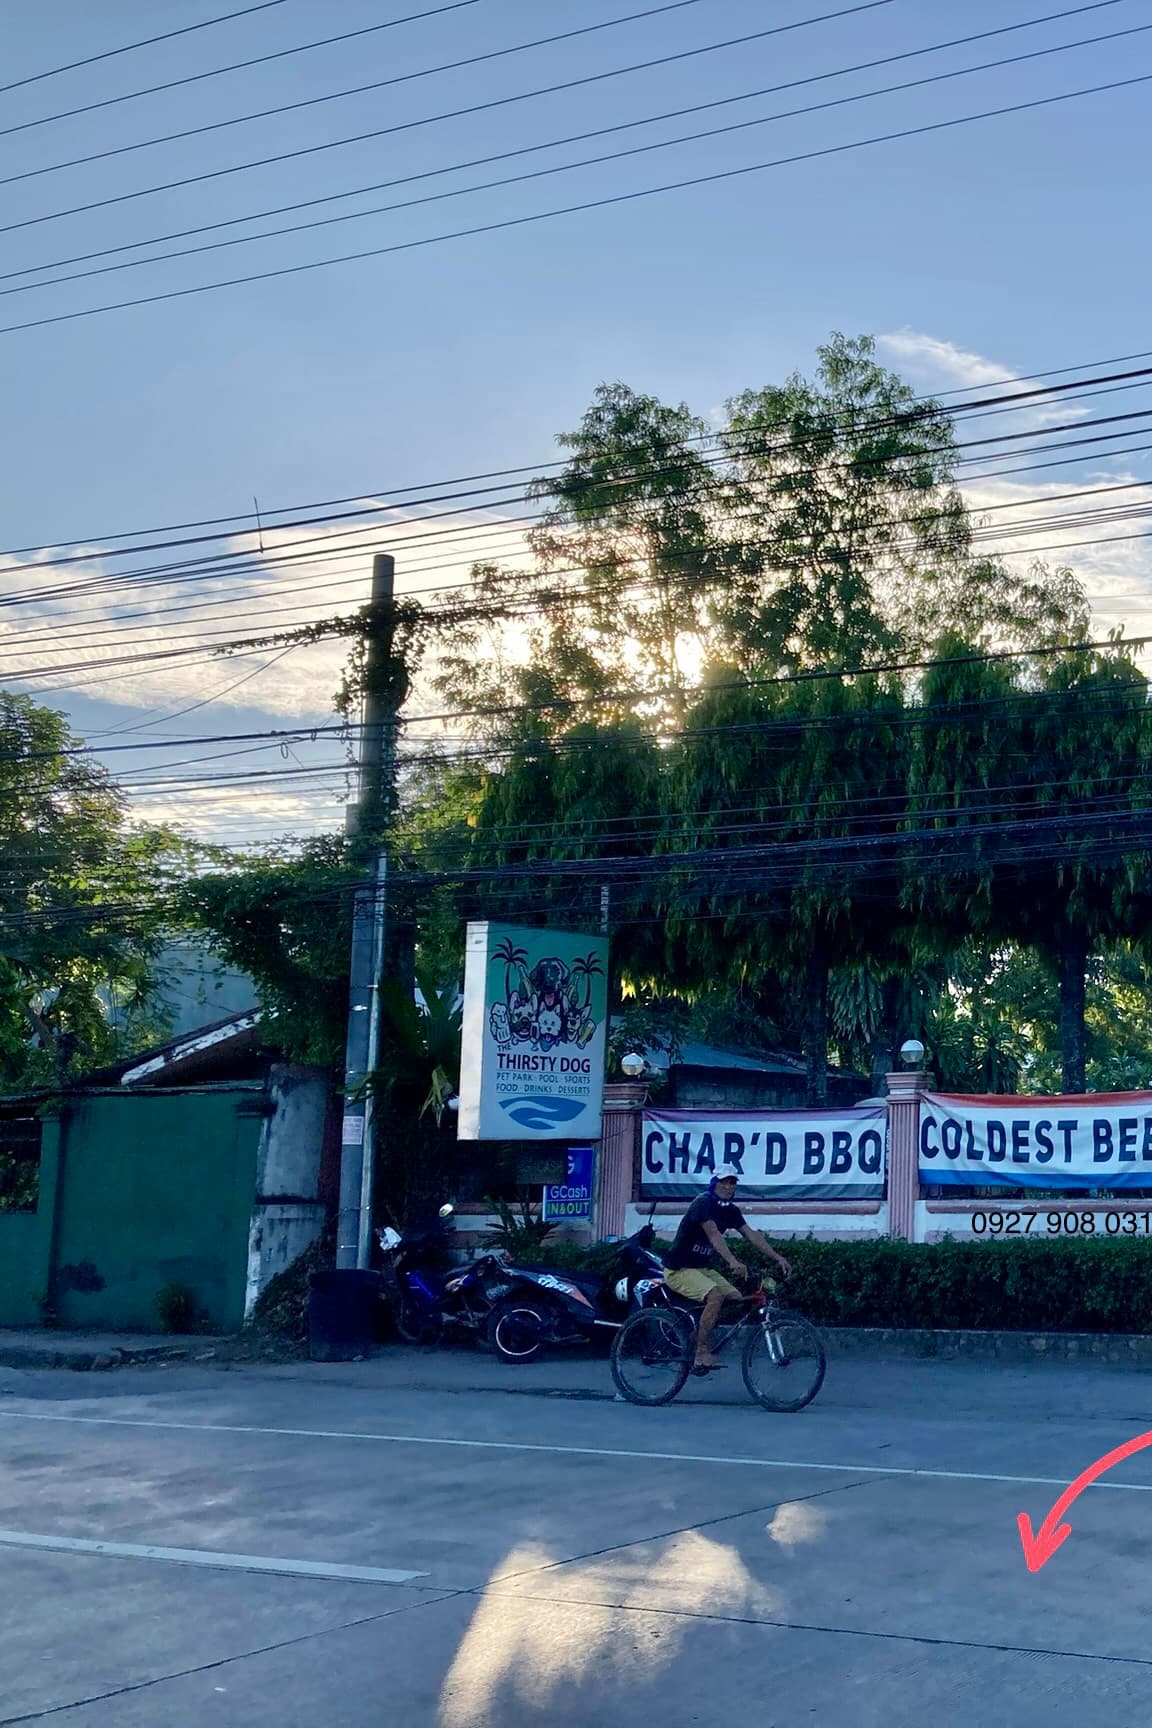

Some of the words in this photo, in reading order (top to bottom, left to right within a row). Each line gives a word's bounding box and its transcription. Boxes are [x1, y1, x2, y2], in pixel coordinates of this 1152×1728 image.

[497, 1044, 511, 1052] THE
[496, 1053, 557, 1072] THIRSTY
[560, 1057, 591, 1073] DOG
[496, 1072, 510, 1081] PET
[512, 1073, 533, 1082] PARK
[539, 1074, 559, 1083] POOL
[564, 1075, 591, 1084] SPORTS
[496, 1083, 519, 1092] FOOD
[524, 1084, 552, 1093] DRINKS
[558, 1085, 590, 1094] DESSERTS
[920, 1115, 1079, 1163] COLDEST
[645, 1131, 788, 1175] CHAR'D
[803, 1128, 883, 1176] BBQ
[550, 1184, 588, 1199] GCash
[547, 1202, 590, 1215] IN&OUT
